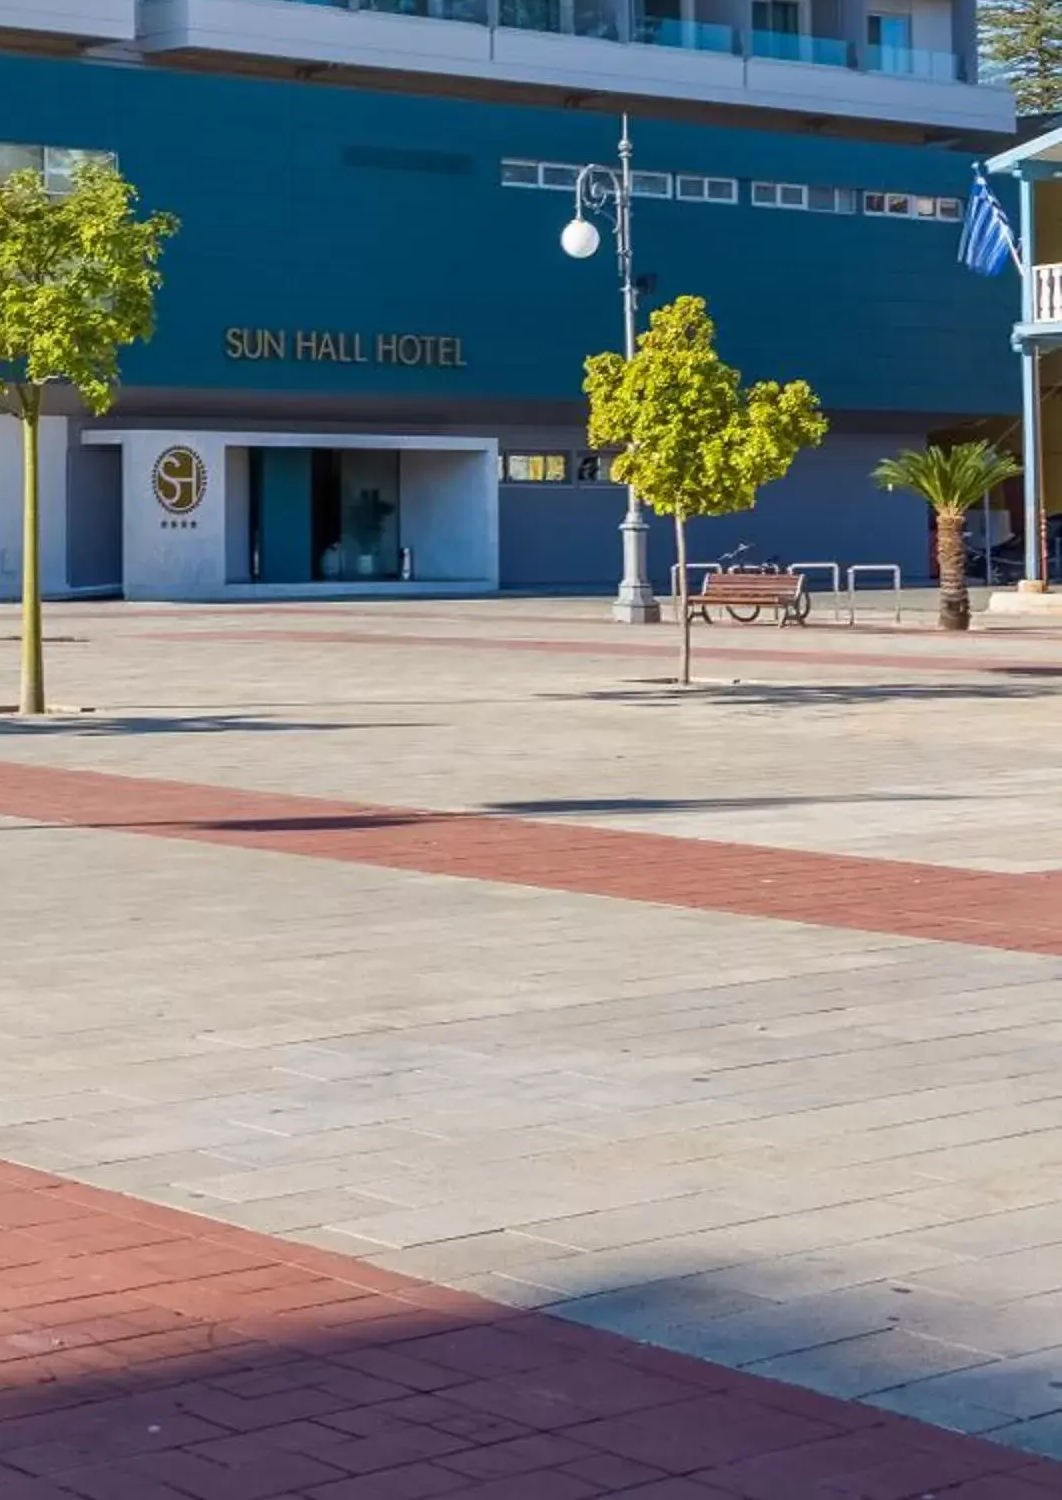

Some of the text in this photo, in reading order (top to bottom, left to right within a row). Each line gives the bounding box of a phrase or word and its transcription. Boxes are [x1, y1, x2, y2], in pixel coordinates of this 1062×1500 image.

[225, 327, 469, 366] SUN HALL HOTEL
